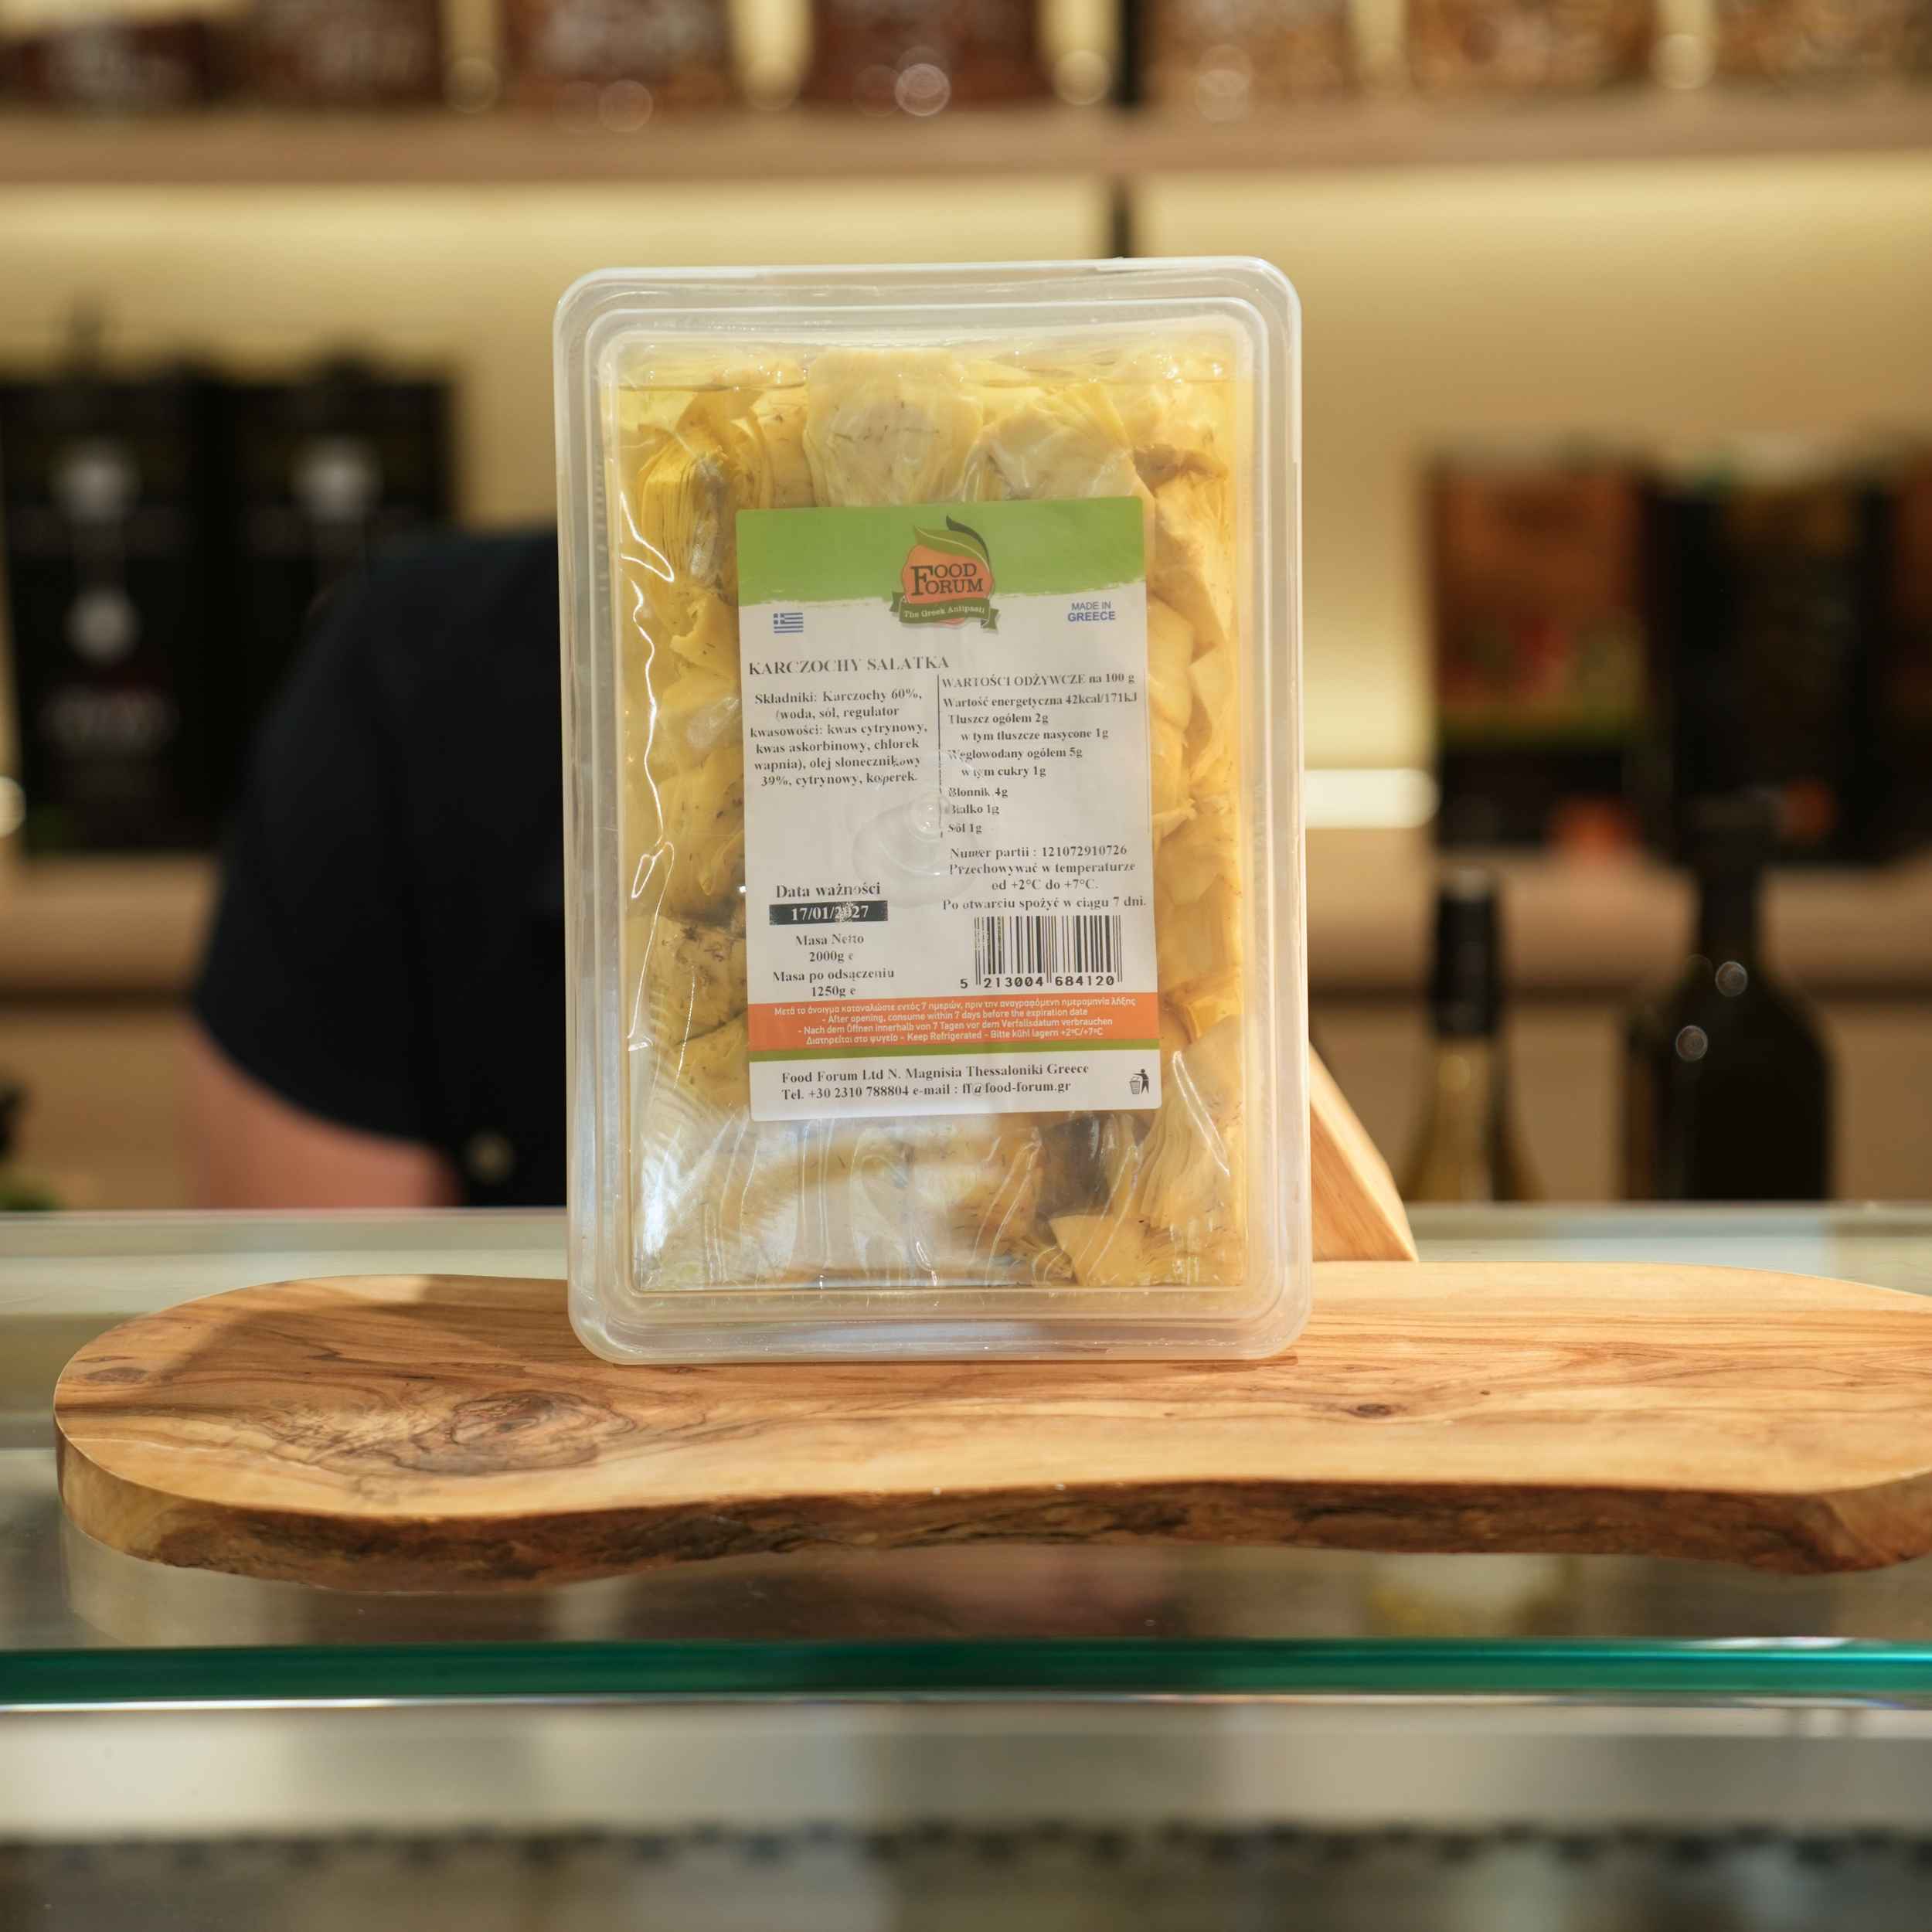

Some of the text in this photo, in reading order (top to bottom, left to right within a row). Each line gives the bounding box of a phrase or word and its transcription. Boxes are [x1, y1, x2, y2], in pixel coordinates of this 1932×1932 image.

[903, 604, 985, 617] The Greek Antipasti
[1071, 601, 1111, 611] MADE IN
[1067, 611, 1116, 621] GREECE
[749, 658, 862, 675] KARCZOCHY
[941, 672, 1135, 688] WARTOŚCI ODŻYWCZE na 100 g
[823, 689, 888, 702] Karczochy
[891, 688, 922, 699] 60%,
[943, 692, 1138, 709] Wartość energetyczna 42kcal/171kJ
[775, 708, 816, 722] (woda,
[843, 706, 900, 720] regulator
[1035, 713, 1049, 725] 2g
[750, 723, 927, 738] kwasowości: kwas cytrynowy,
[973, 731, 994, 743] tym
[1043, 730, 1092, 741] nasycone
[1095, 727, 1109, 740] 1g
[756, 737, 920, 754] kwas askorbinowy, chlorek
[1069, 747, 1083, 759] 5g
[753, 758, 806, 773] wapnia),
[809, 757, 831, 770] olej
[997, 766, 1029, 778] cukry
[1032, 765, 1046, 777] 1g
[761, 770, 918, 788] 39%, cytrynowy, koperek.
[995, 787, 1009, 799] 4g
[986, 804, 1000, 816] 1g
[969, 822, 982, 835] 1g
[950, 848, 992, 859] Numer
[995, 846, 1029, 860] partii
[1042, 844, 1128, 857] 121072910726
[949, 862, 1038, 876] Przechowywać
[1055, 862, 1136, 876] temperaturze
[776, 881, 881, 898] Data ważności
[992, 878, 1099, 890] od +2°C do +7°C.
[943, 899, 958, 910] Po
[963, 897, 1015, 910] otwarciu
[1019, 896, 1060, 911] spożyć
[1077, 896, 1109, 910] ciągu
[1113, 896, 1120, 906] 7
[1124, 895, 1147, 906] dni.
[791, 905, 869, 921] 17/01/2027
[795, 933, 864, 946] Masa Netto
[809, 951, 854, 963] 2000g e
[773, 968, 895, 984] Masa po odsączeniu
[960, 975, 1115, 989] 5 213004 684120
[811, 985, 856, 998] 1250g e
[774, 1006, 795, 1015] Μετά
[808, 1005, 840, 1015] άνοιγμα
[841, 1003, 896, 1013] καταναλώστε
[897, 1002, 920, 1012] εντός
[928, 1001, 963, 1011] ημερών,
[964, 1000, 982, 1010] πριν
[985, 1000, 998, 1009] την
[1062, 996, 1110, 1007] ημερομηνία
[1111, 996, 1136, 1006] λήξης
[828, 1015, 849, 1024] After
[850, 1014, 886, 1024] opening,
[887, 1013, 926, 1022] consume
[927, 1012, 953, 1020] within
[954, 1011, 960, 1019] 7
[961, 1011, 981, 1021] days
[982, 1009, 1009, 1019] before
[1011, 1009, 1025, 1017] the
[1026, 1008, 1068, 1019] expiration
[1070, 1008, 1088, 1016] date
[804, 1026, 825, 1035] Nach
[827, 1025, 845, 1034] dem
[846, 1023, 873, 1033] Öffnen
[876, 1022, 914, 1032] innerhalb
[940, 1021, 964, 1031] Tagen
[981, 1020, 1000, 1029] dem
[1001, 1019, 1060, 1028] Verfallsdatum
[1061, 1017, 1113, 1026] verbrauchen
[806, 1035, 852, 1046] Διατηρείται
[869, 1032, 898, 1043] ψυγείο
[907, 1032, 928, 1042] Keep
[930, 1030, 982, 1042] Refrigerated
[991, 1029, 1010, 1038] Bitte
[1012, 1029, 1030, 1037] kühl
[1032, 1028, 1059, 1039] lagern
[782, 1063, 1089, 1083] Food Forum Ltd N. Magnisia Thessaloniki Greece
[781, 1088, 804, 1100] Tel.
[808, 1087, 831, 1098] +30
[835, 1086, 862, 1098] 2310
[866, 1085, 909, 1097] 788804
[913, 1083, 951, 1096] e-mail
[962, 1081, 1071, 1096] ff@food-forum.gr
